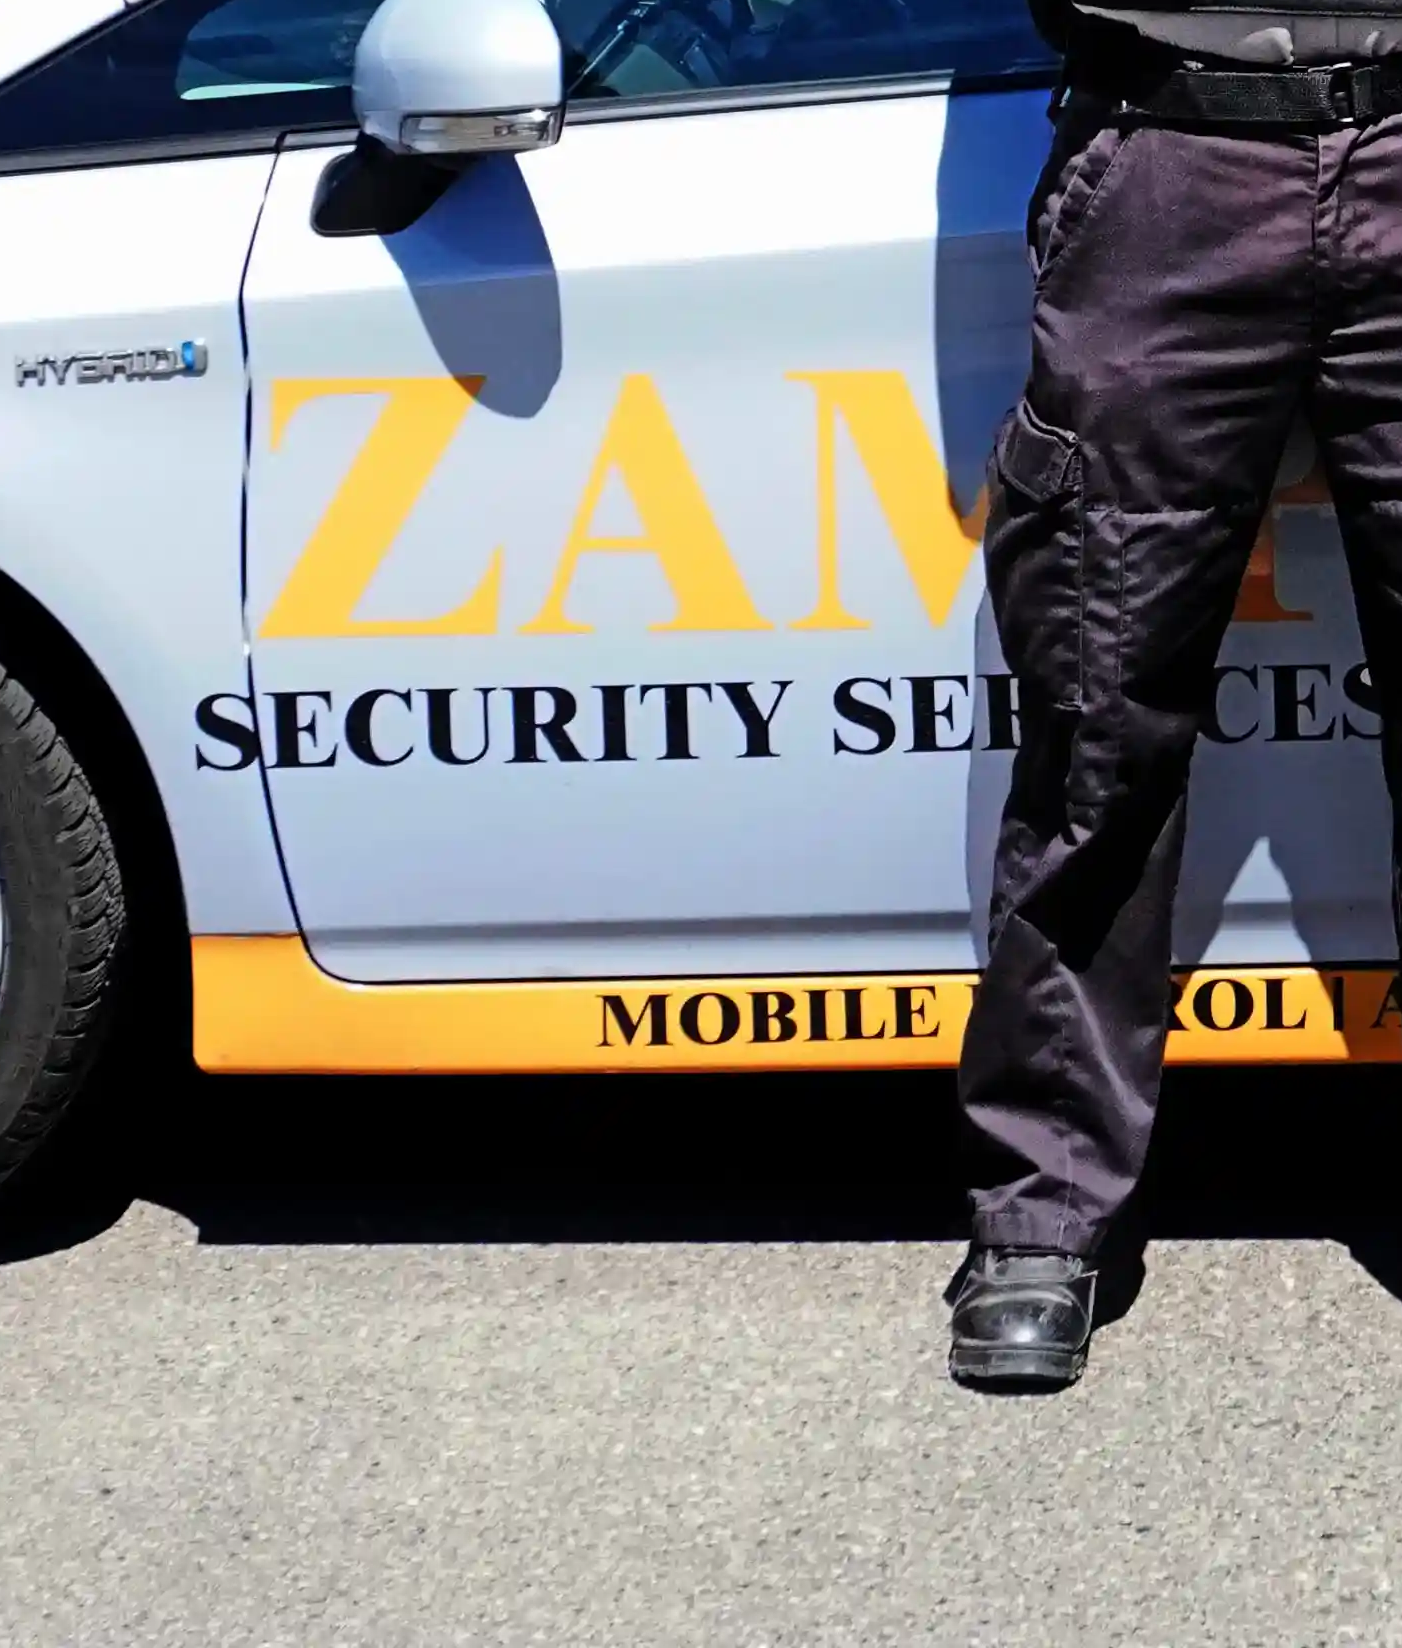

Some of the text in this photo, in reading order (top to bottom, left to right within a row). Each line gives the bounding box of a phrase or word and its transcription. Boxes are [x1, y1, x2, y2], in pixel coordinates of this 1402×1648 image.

[15, 348, 178, 387] HYBRID
[194, 663, 1384, 771] SECURITY SERCES
[596, 984, 941, 1047] MOBILE
